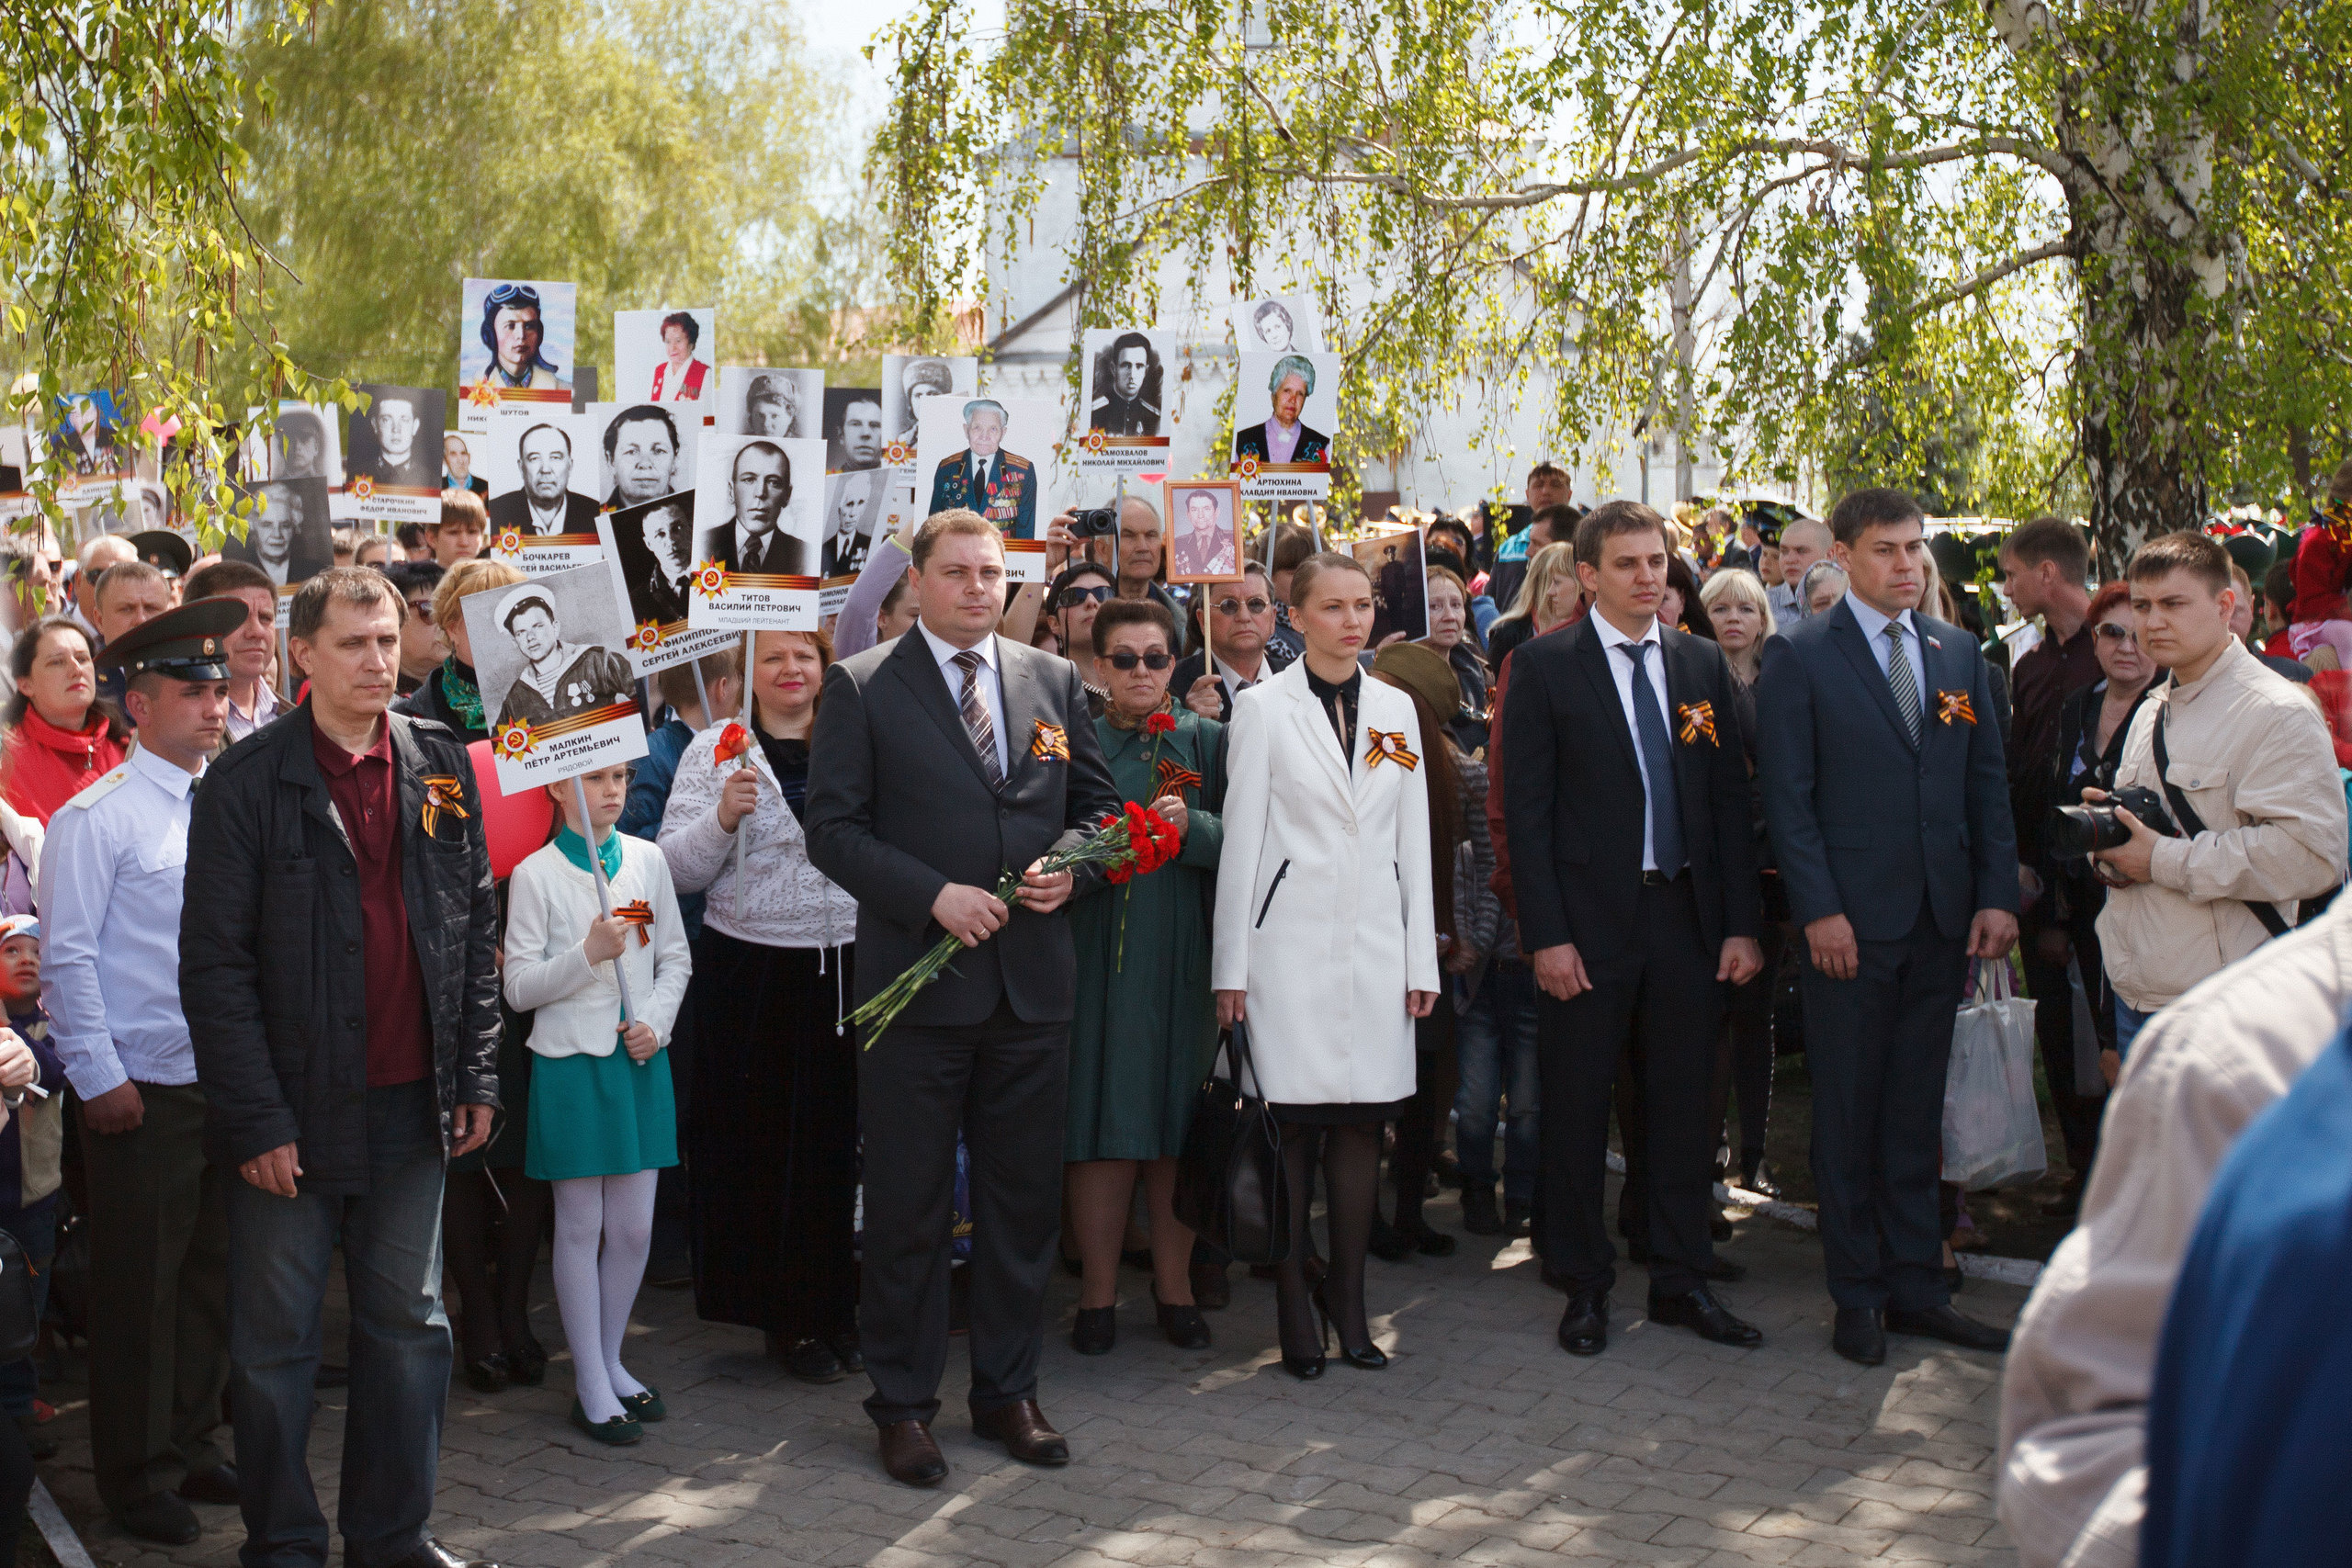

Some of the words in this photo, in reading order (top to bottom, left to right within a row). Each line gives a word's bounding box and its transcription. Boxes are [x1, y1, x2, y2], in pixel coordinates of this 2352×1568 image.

[1082, 458, 1115, 467] НИКОЛАЙ
[372, 497, 415, 505] СТАРОЧКИН
[360, 505, 385, 513] ФЕДОР
[387, 506, 427, 515] ИВАНОВИЧ
[523, 552, 571, 561] БОЧКАРЕВ
[741, 593, 771, 603] ТИТОВ
[708, 602, 752, 612] ВАСИЛИЙ
[753, 604, 801, 613] ПЕТРОВИЧ
[718, 615, 752, 625] МЛАДШИЙ
[752, 616, 790, 625] ЛЕЙТЕНАНТ
[641, 648, 680, 668] СЕРГЕЙ
[548, 734, 593, 753] МАЛКИН
[525, 756, 550, 771] ПЁТР
[554, 736, 621, 762] АРТЕМЬЕВИЧ
[557, 758, 594, 774] РЯДОВОЙ
